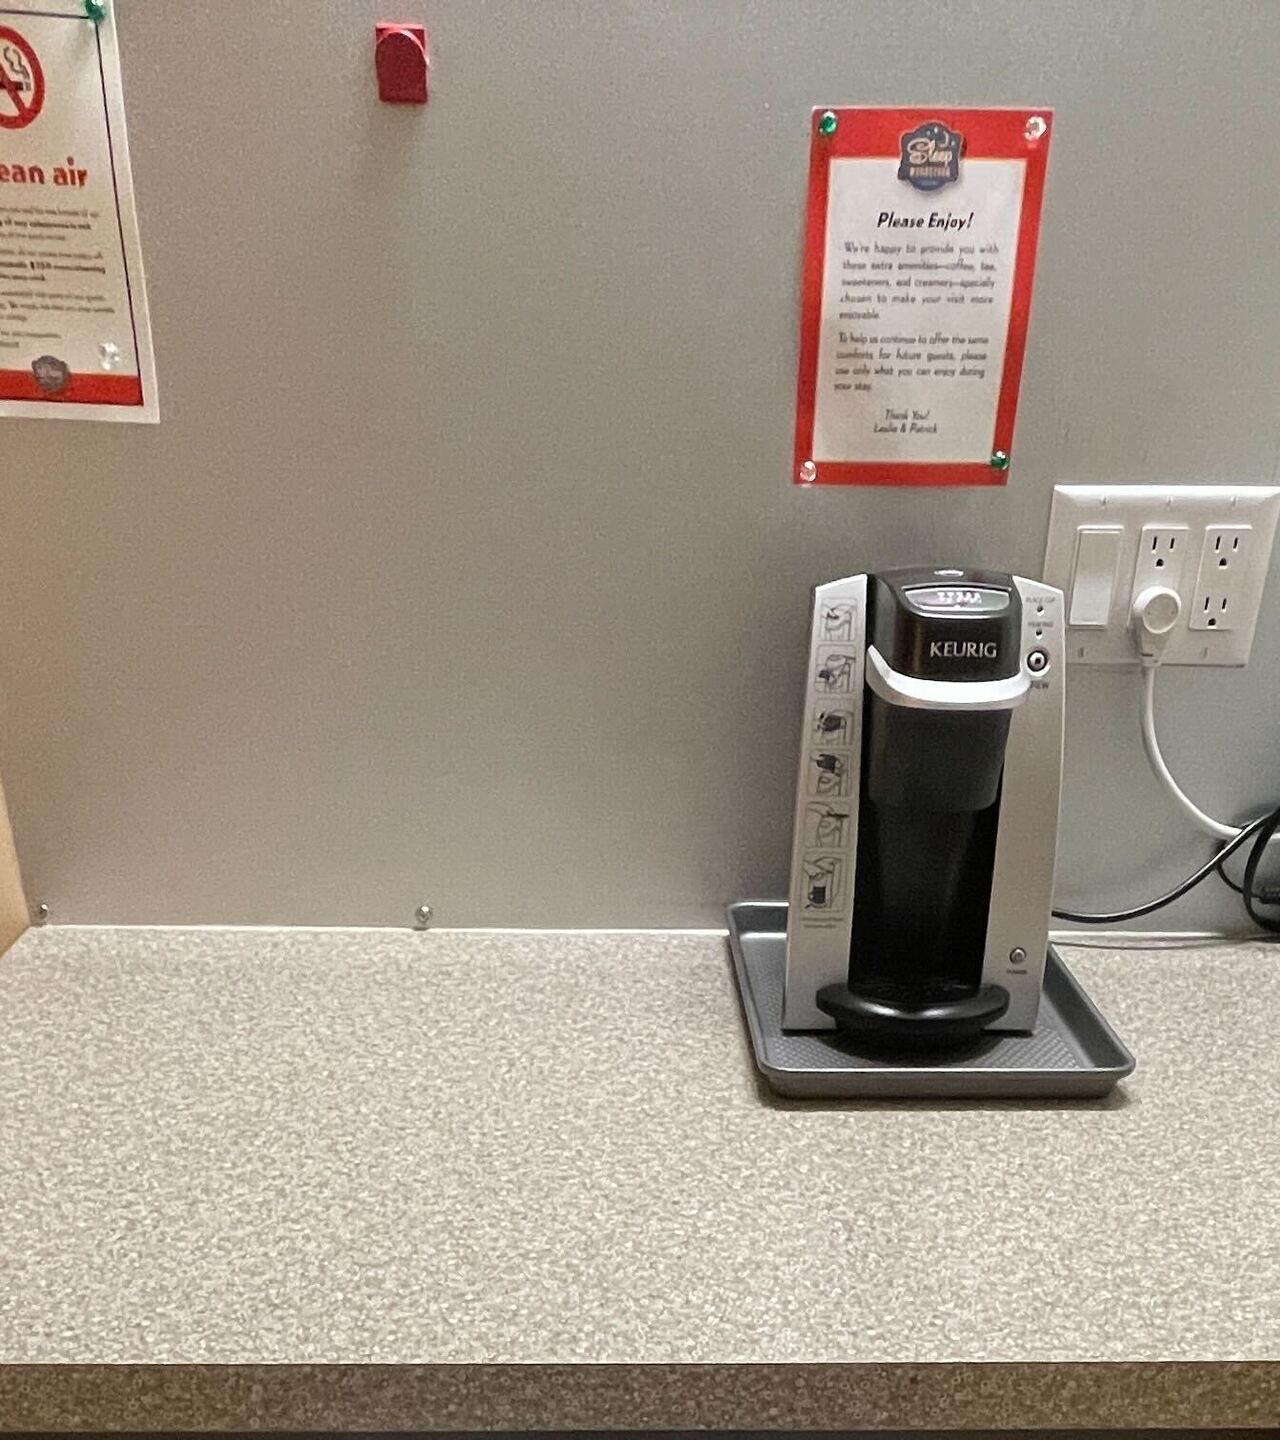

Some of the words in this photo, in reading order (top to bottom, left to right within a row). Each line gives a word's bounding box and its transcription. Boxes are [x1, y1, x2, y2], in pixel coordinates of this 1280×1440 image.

[53, 156, 88, 188] air
[877, 211, 924, 229] Please
[927, 211, 974, 232] Enjoy!
[874, 241, 901, 256] happy
[906, 243, 916, 254] to
[920, 241, 954, 256] provide
[959, 245, 975, 259] you
[979, 241, 999, 254] with
[871, 260, 893, 271] extra
[896, 276, 911, 287] and
[877, 294, 887, 304] to
[891, 291, 916, 304] make
[921, 295, 941, 305] your
[947, 292, 965, 304] visit
[970, 296, 994, 304] more
[850, 331, 868, 346] help
[880, 335, 916, 344] continue
[929, 332, 949, 345] offer
[952, 335, 966, 344] the
[968, 336, 989, 344] same
[879, 347, 891, 360] for
[896, 347, 921, 360] future
[960, 349, 987, 361] please
[874, 365, 894, 376] what
[898, 367, 913, 378] you
[916, 367, 931, 376] can
[934, 367, 956, 377] enjoy
[959, 365, 985, 378] during
[885, 408, 908, 420] Thank
[912, 408, 930, 420] You!
[909, 422, 937, 434] Patrick
[930, 641, 998, 659] KEURIG
